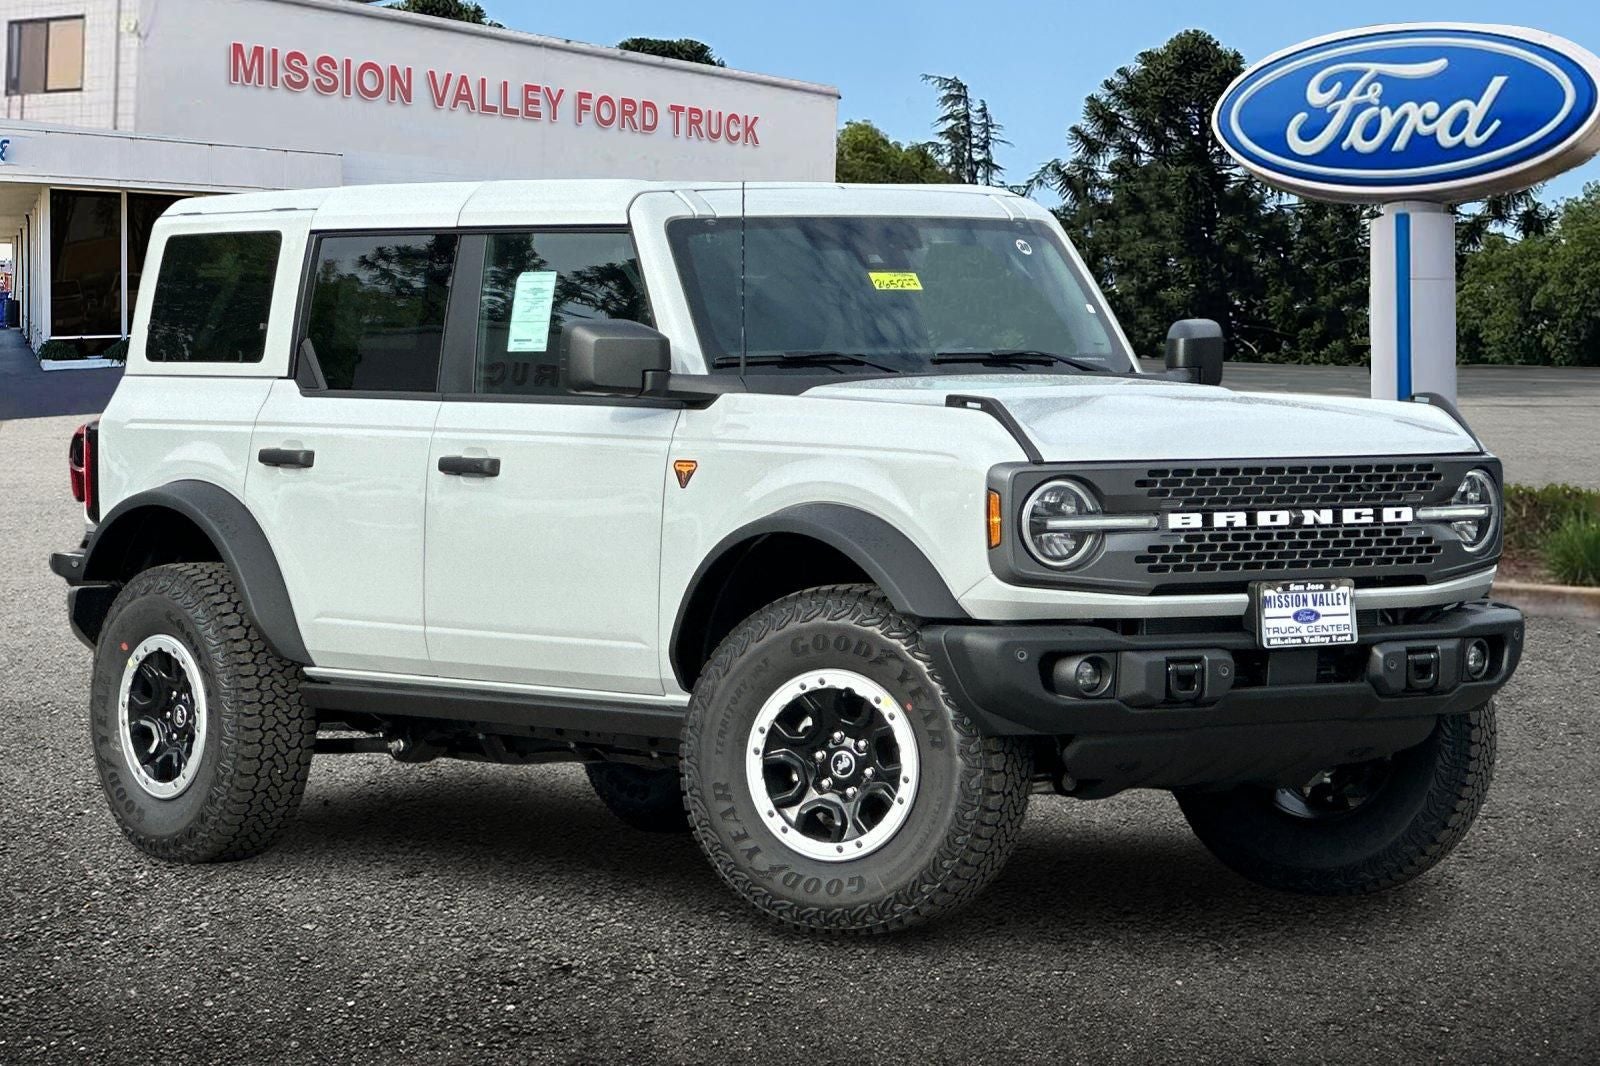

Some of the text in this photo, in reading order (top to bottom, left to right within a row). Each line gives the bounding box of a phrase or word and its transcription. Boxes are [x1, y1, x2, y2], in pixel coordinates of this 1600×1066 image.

[230, 41, 761, 146] MISSION VALLEY FORD TRUCK
[1286, 57, 1509, 156] Ford
[1167, 506, 1413, 529] BRONCO
[1289, 582, 1325, 591] San Jose
[1264, 592, 1348, 609] MISSION VALLEY
[1298, 611, 1316, 621] Ford
[1266, 624, 1351, 635] TRUCK CENTER
[712, 782, 866, 897] GOODYEAR
